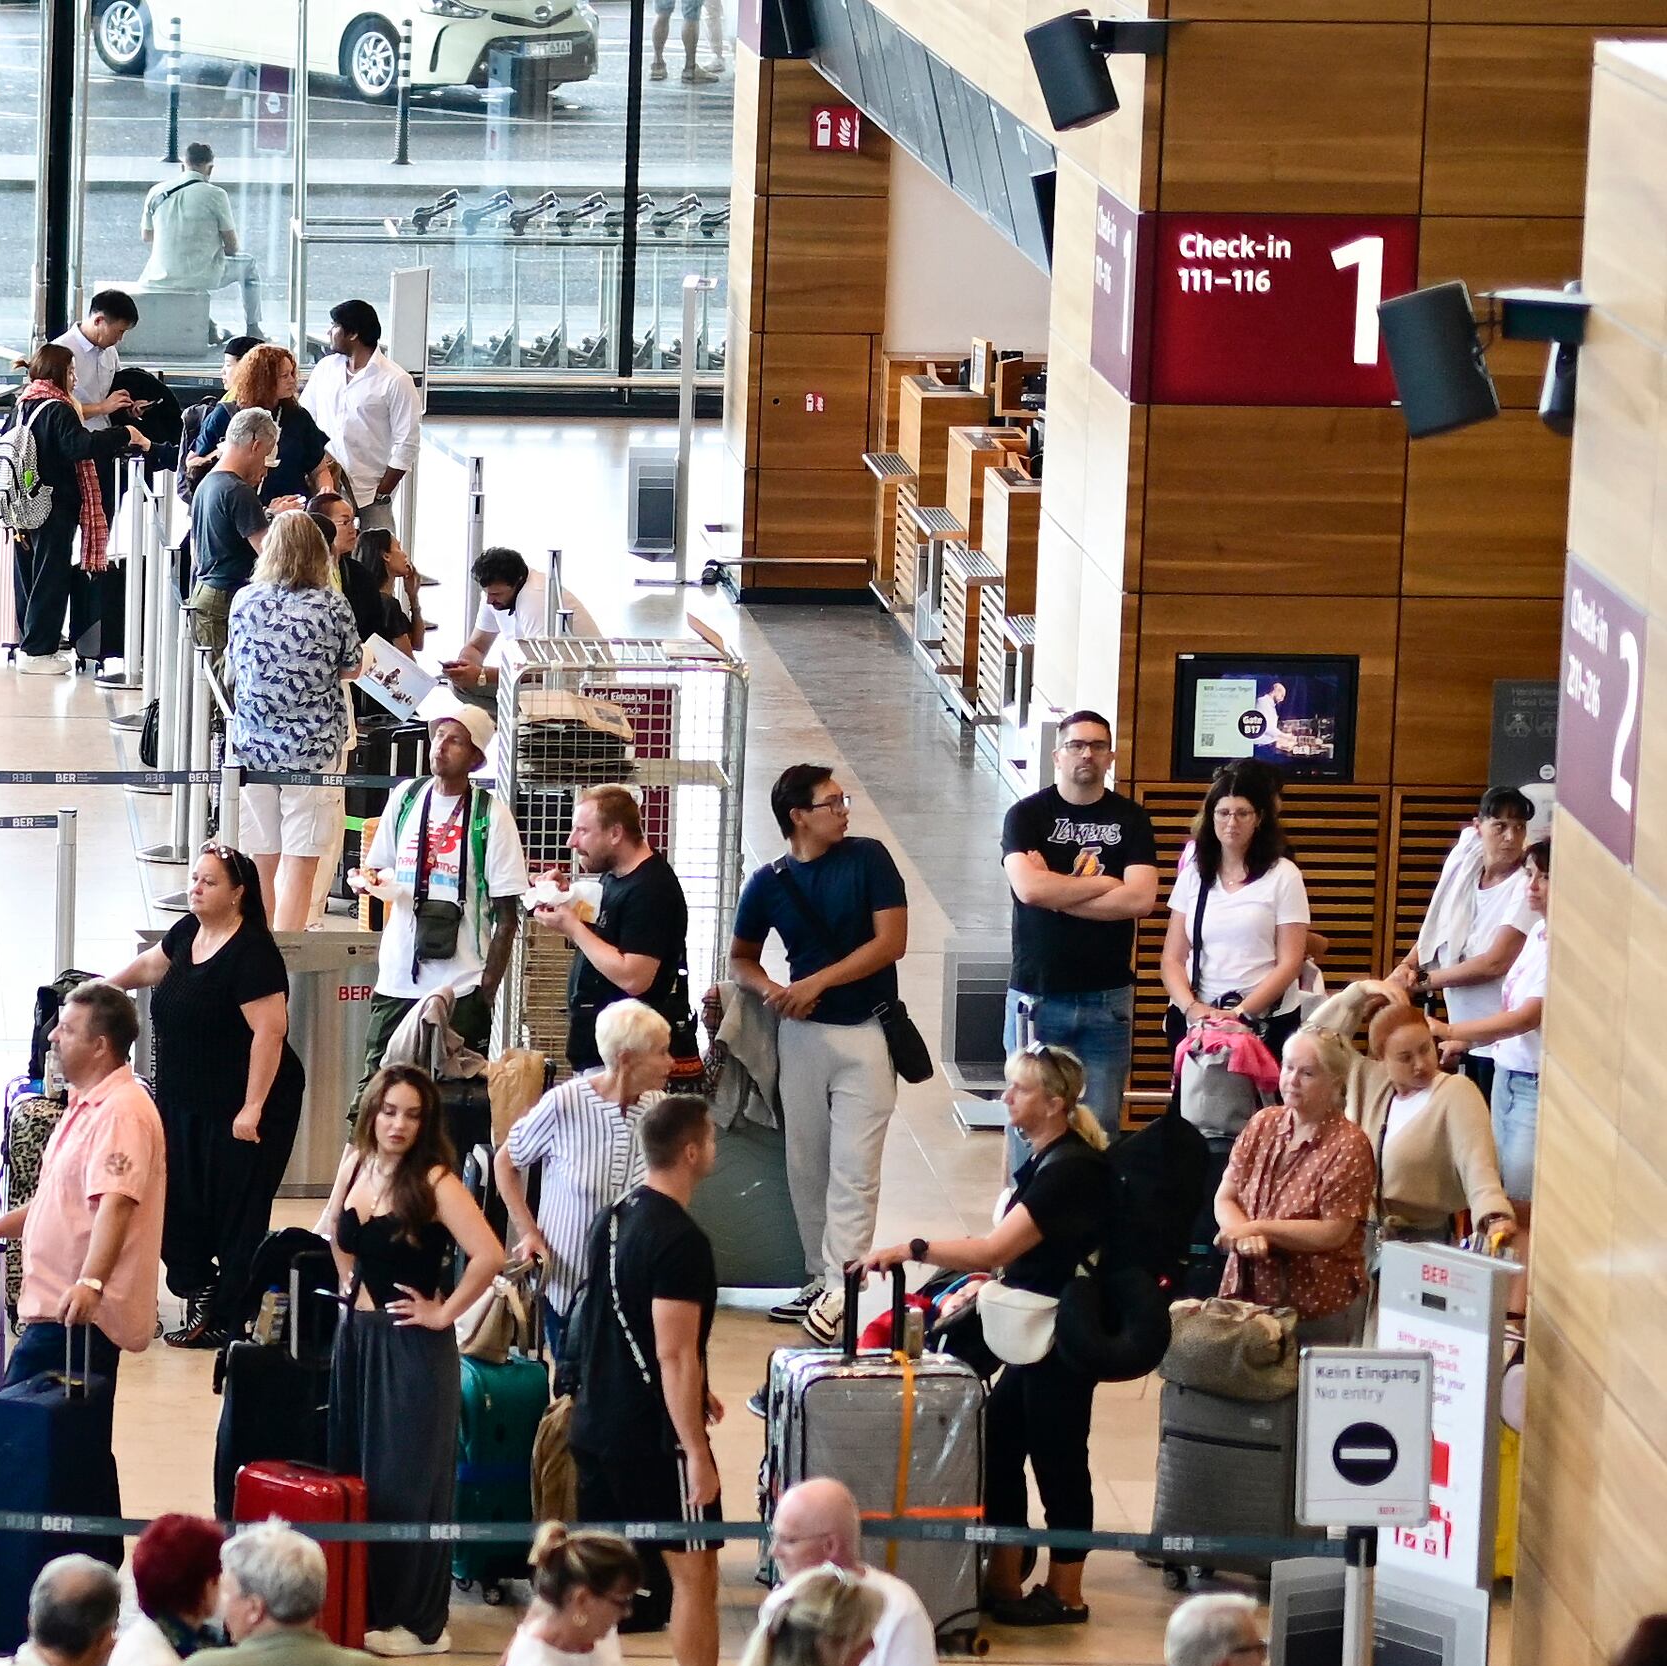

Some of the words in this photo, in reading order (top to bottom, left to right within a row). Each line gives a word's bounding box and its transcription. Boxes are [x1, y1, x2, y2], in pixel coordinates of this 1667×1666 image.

[1179, 233, 1291, 259] Check-in
[1330, 236, 1384, 364] 1
[1571, 588, 1608, 655] Check-in
[610, 691, 647, 702] Eingang
[1242, 715, 1263, 725] Gate
[1610, 630, 1639, 813] 2
[55, 773, 76, 783] BER
[188, 773, 209, 783] BER
[322, 775, 343, 785] BER
[12, 817, 34, 827] BER
[1047, 818, 1122, 845] LAKERS
[338, 986, 372, 1001] BER
[1422, 1264, 1449, 1286] BER
[1315, 1366, 1351, 1380] Kein
[1354, 1366, 1421, 1386] Eingang
[1316, 1388, 1337, 1401] No
[1341, 1387, 1385, 1403] entry
[42, 1516, 73, 1530] BER
[430, 1524, 461, 1539] BER
[965, 1527, 996, 1541] BER
